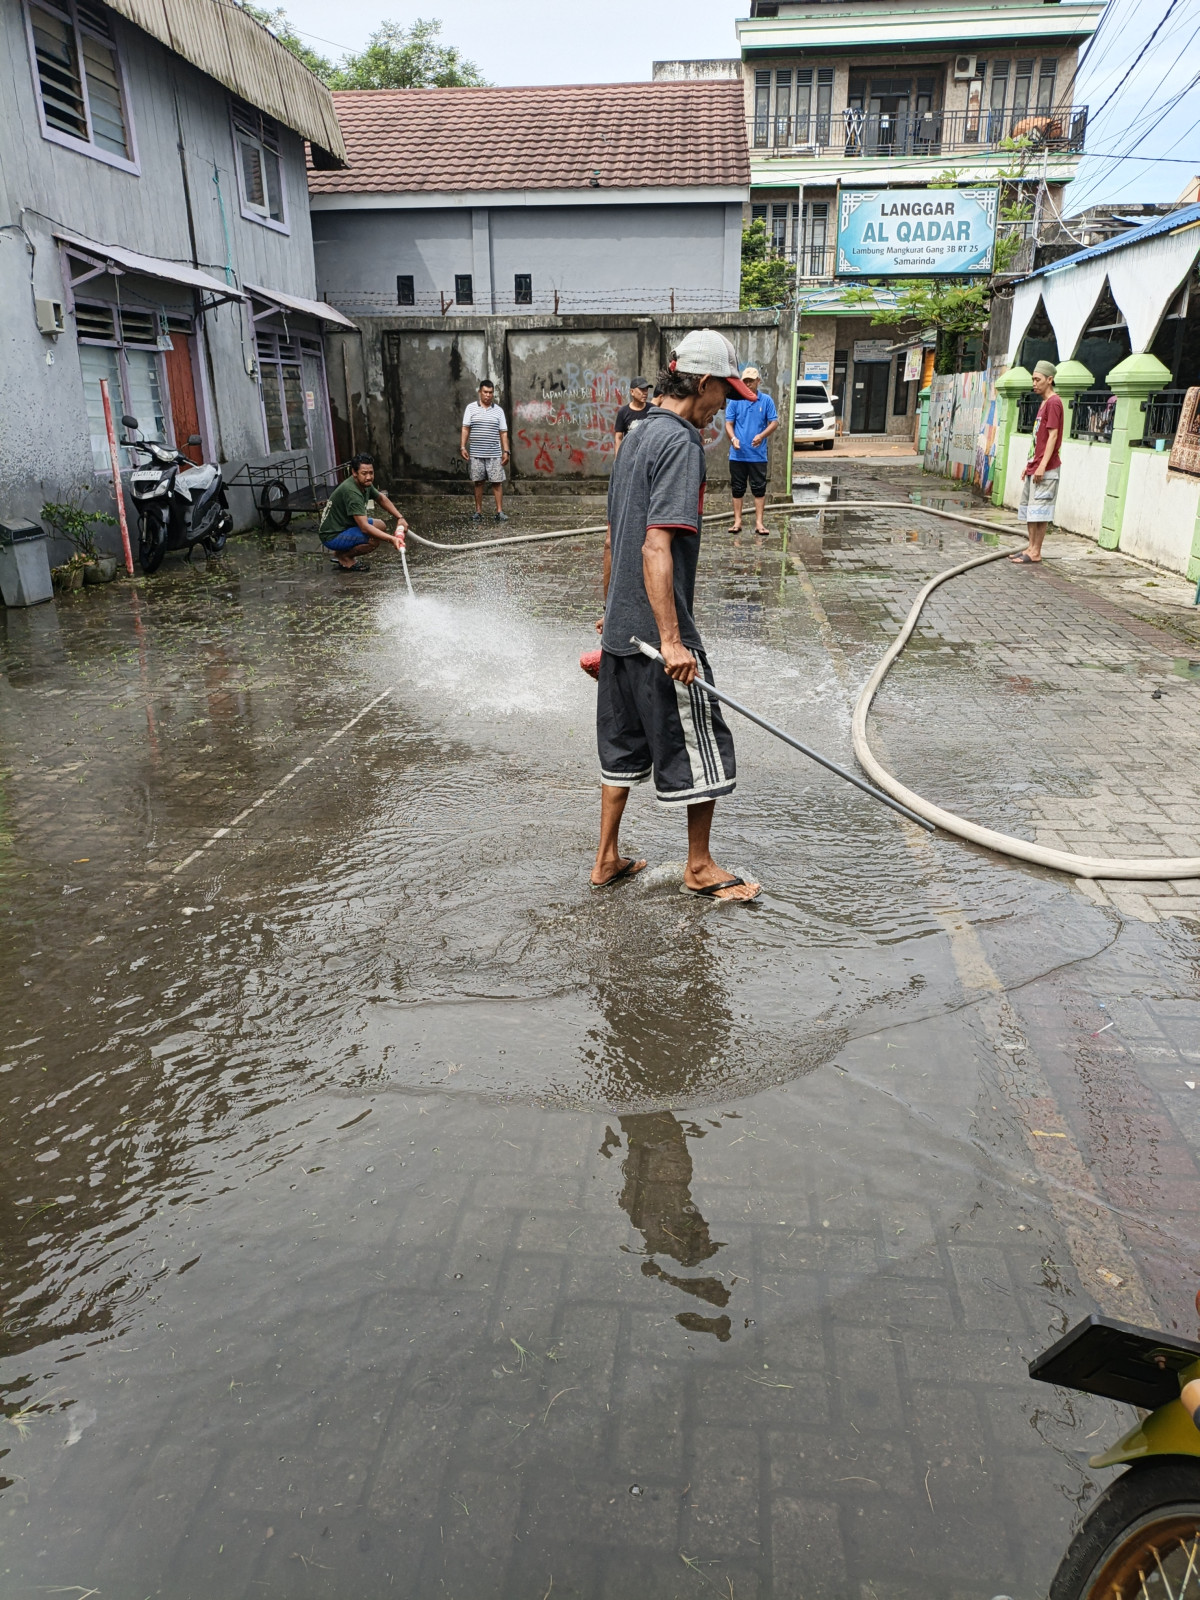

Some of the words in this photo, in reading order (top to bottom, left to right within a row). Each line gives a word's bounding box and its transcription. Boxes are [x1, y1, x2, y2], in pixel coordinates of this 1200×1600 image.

[881, 202, 955, 216] LANGGAR
[862, 222, 889, 243] AL
[896, 220, 971, 243] QADAR
[852, 247, 885, 256] Lambung
[886, 246, 924, 255] Mangkurat
[926, 246, 944, 254] Gang
[957, 245, 967, 253] RT
[893, 257, 936, 266] Samarinda
